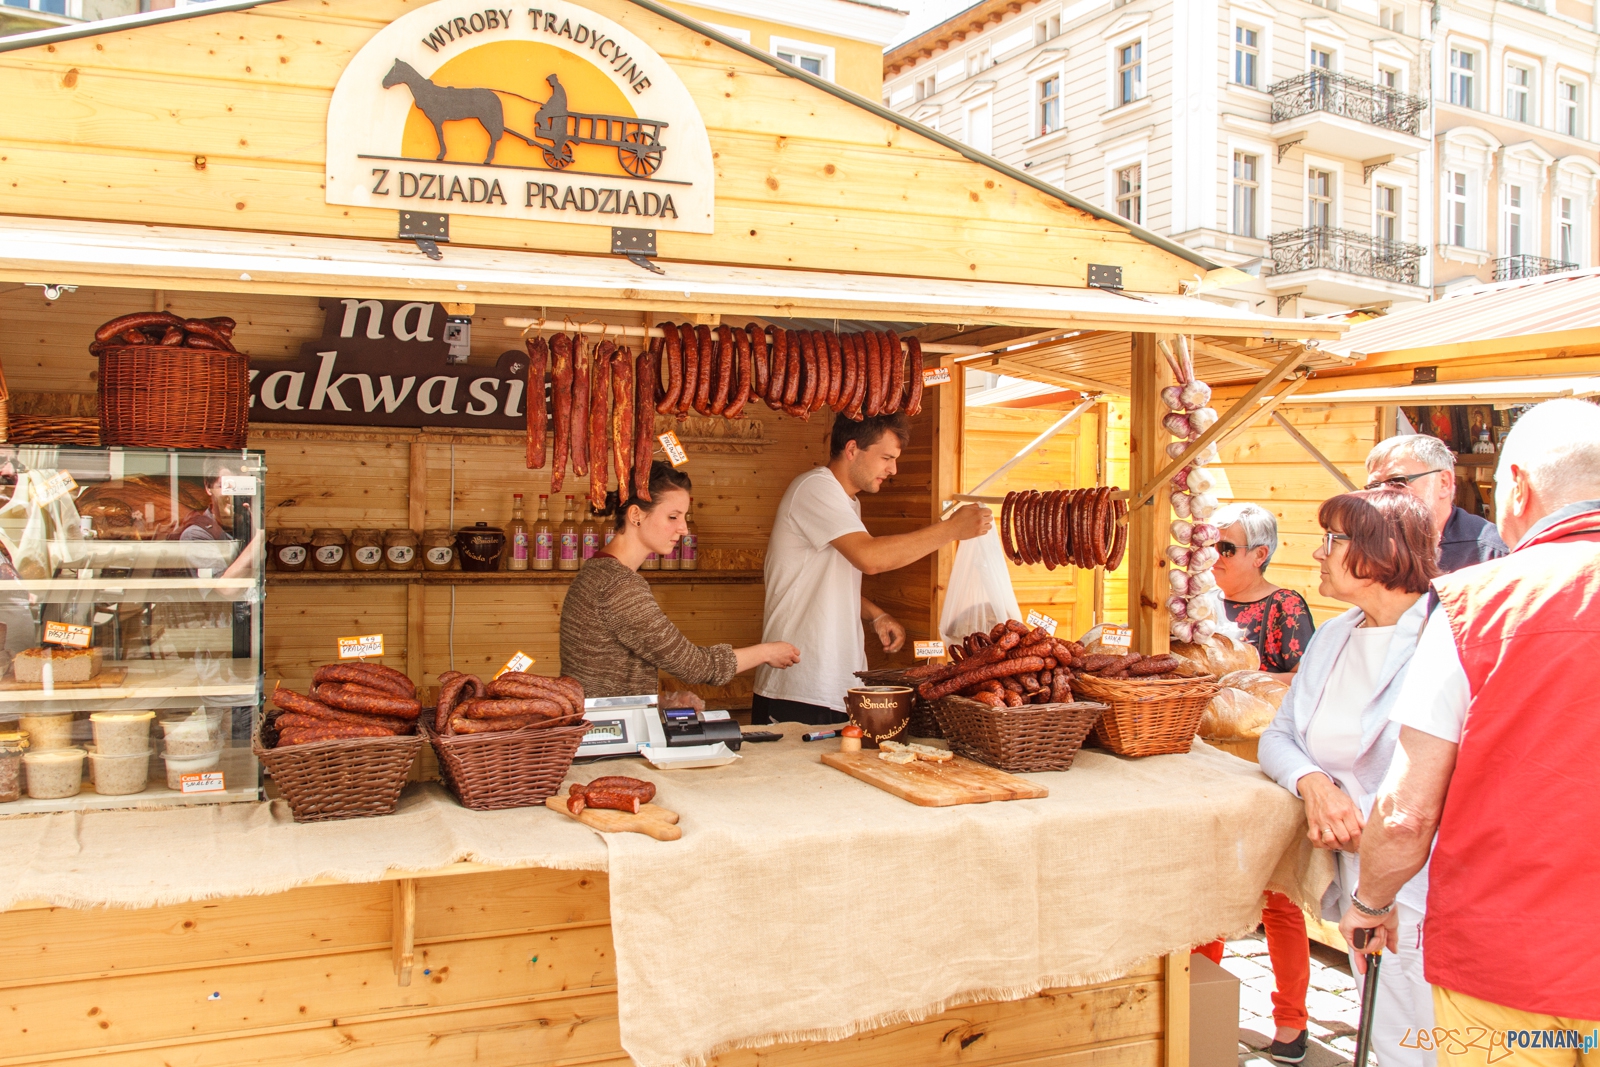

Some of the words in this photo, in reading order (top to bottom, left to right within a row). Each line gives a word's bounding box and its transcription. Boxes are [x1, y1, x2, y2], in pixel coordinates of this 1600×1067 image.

[422, 8, 513, 53] WYROBY
[528, 8, 652, 95] TRADYCYJNE
[371, 168, 390, 195] Z
[399, 171, 508, 206] DZIADA
[525, 181, 679, 219] PRADZIADA
[340, 299, 435, 342] na
[248, 351, 553, 420] akwasi
[859, 694, 898, 710] Smalec
